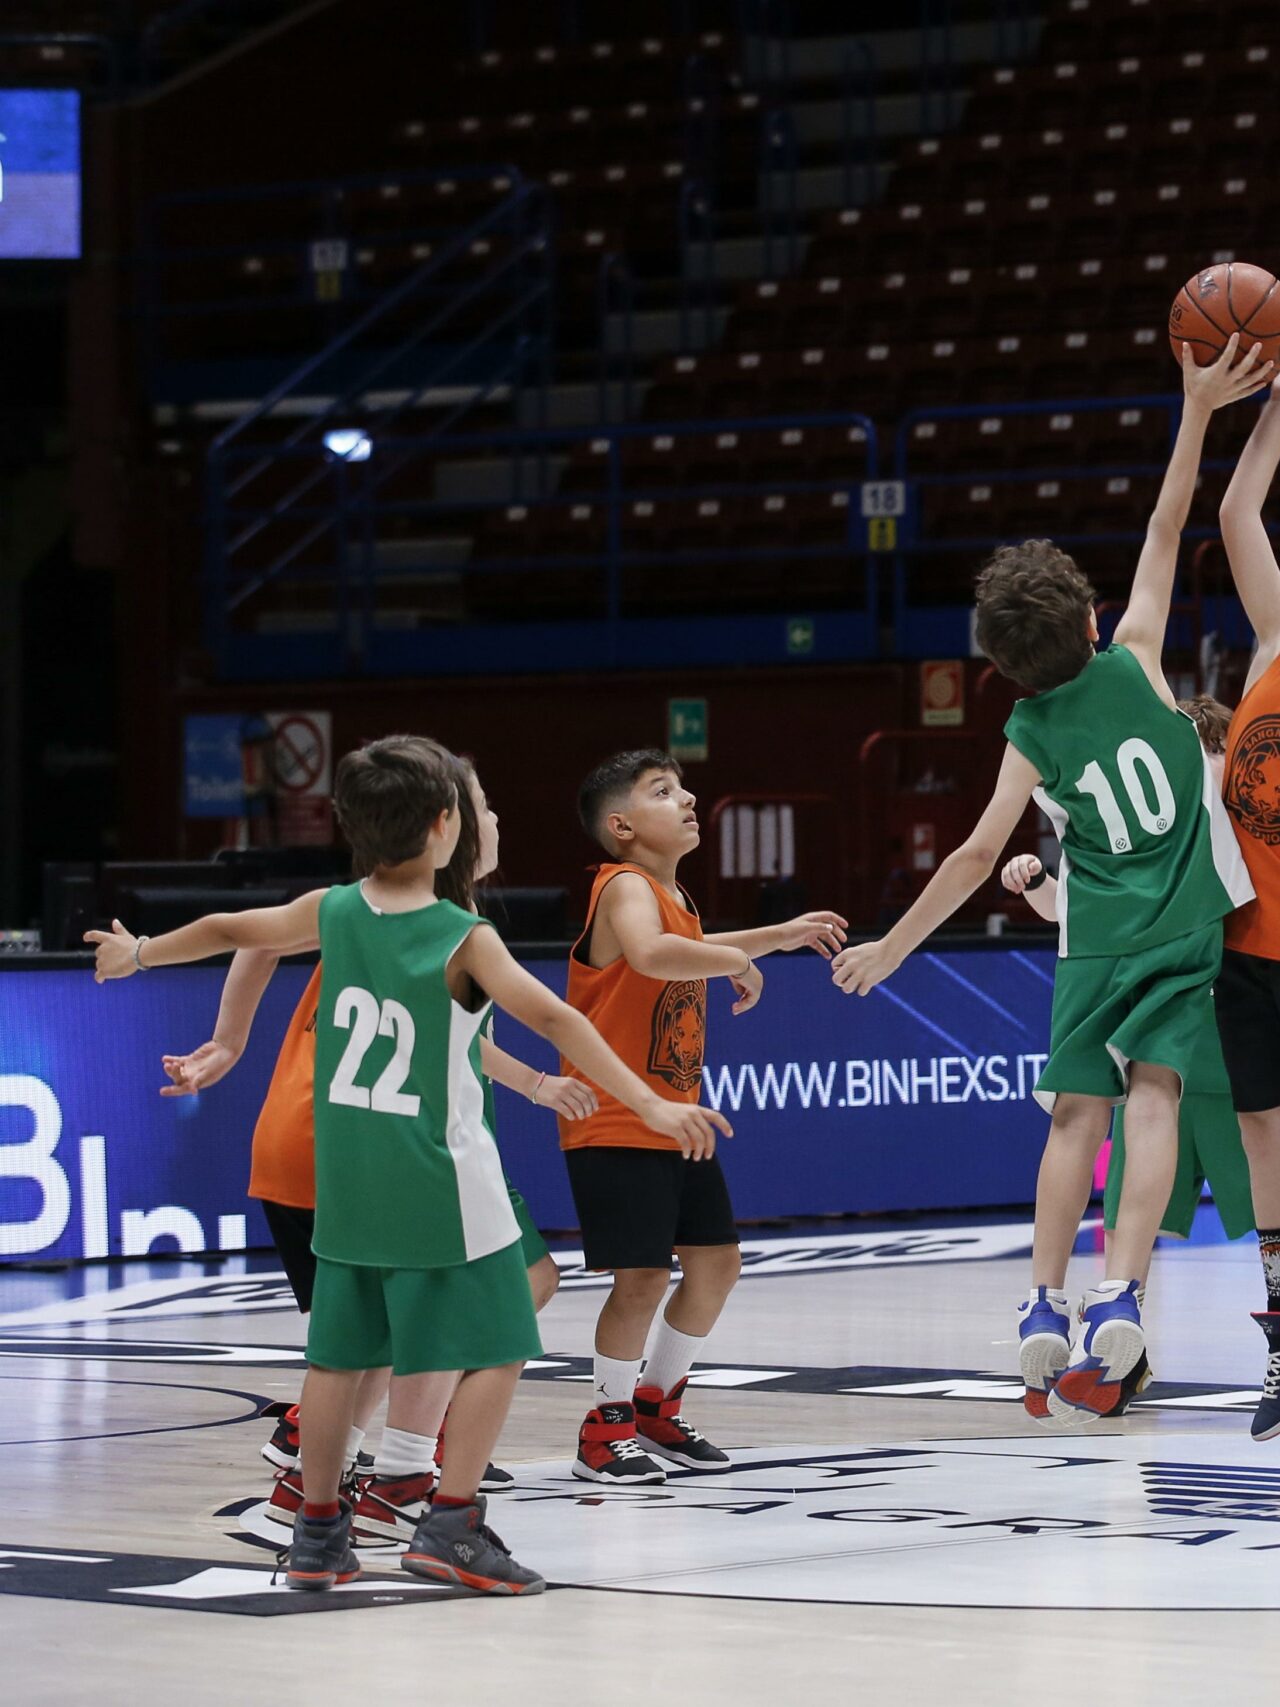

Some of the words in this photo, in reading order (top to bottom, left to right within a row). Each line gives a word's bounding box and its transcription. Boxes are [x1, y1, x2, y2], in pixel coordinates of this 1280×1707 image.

[1074, 737, 1176, 855] 10
[328, 985, 422, 1117] 22
[702, 1053, 1049, 1112] WWW.BINHEXS.IT
